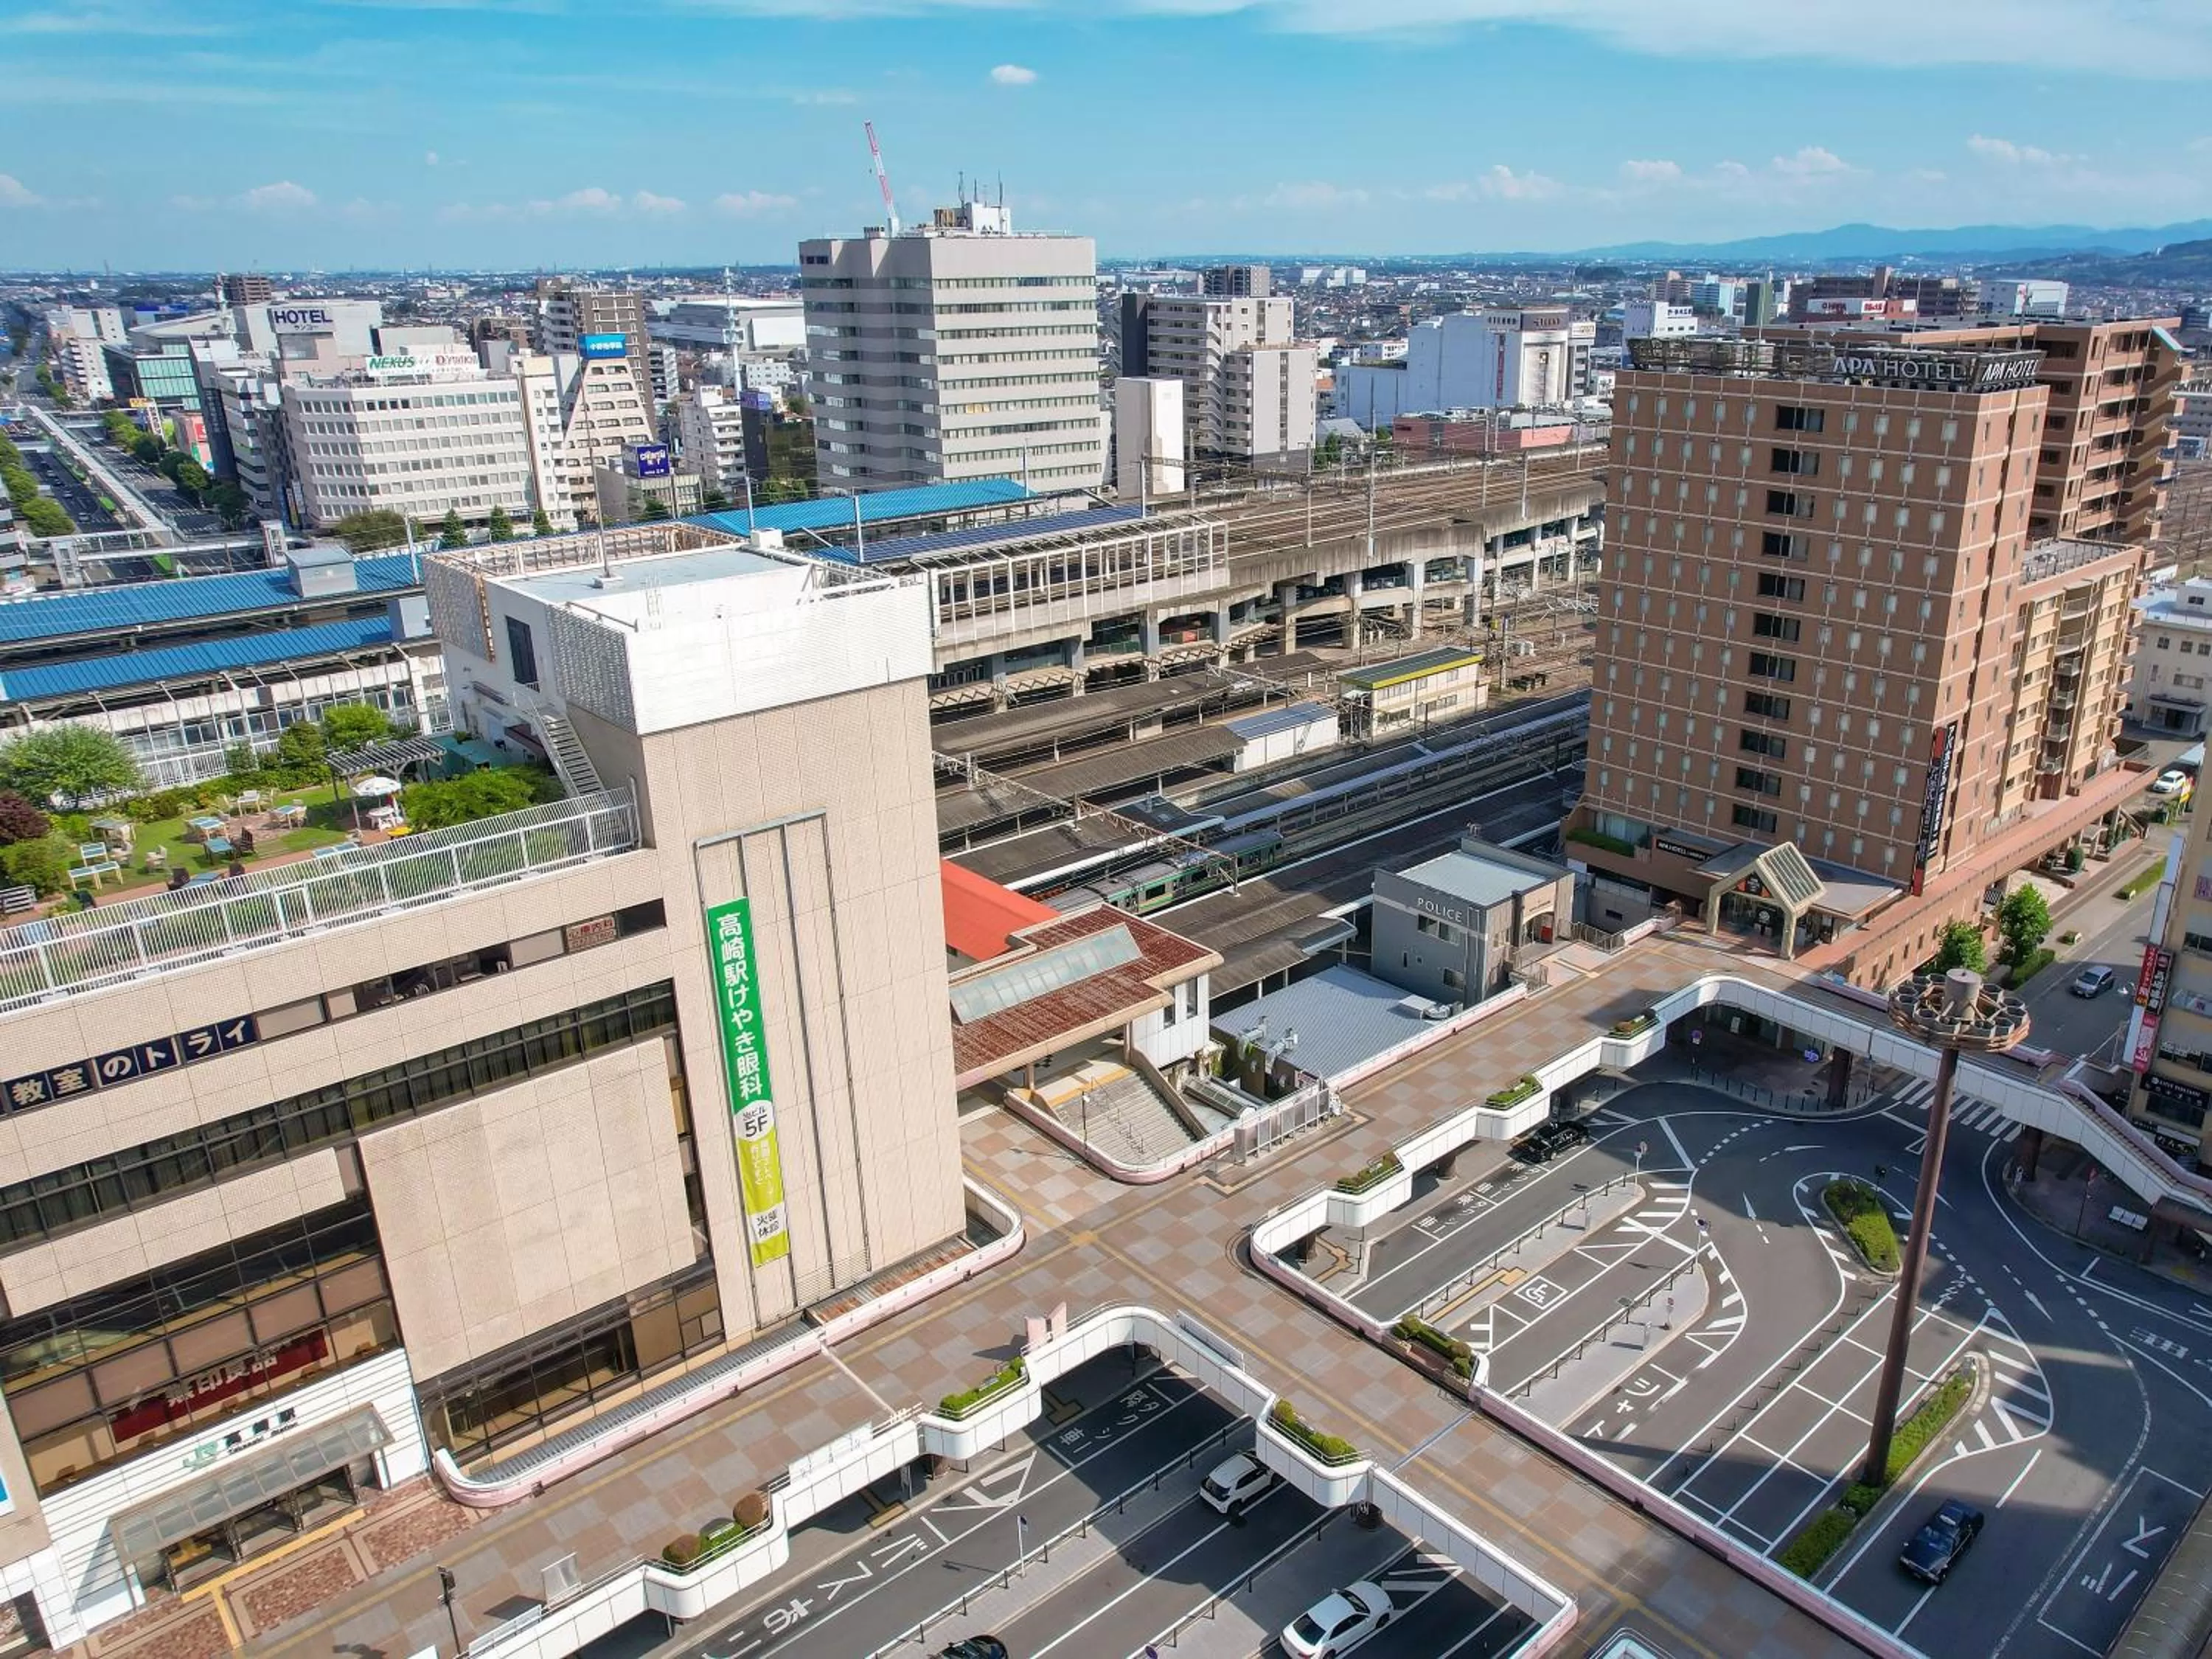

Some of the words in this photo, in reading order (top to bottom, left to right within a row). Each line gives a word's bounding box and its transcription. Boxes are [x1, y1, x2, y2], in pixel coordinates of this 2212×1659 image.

[274, 309, 333, 324] HOTEL
[369, 355, 416, 369] NEXUS
[1833, 357, 1876, 375] APA
[1884, 359, 1963, 380] HOTEL
[1982, 363, 2004, 381] APA
[2006, 359, 2039, 379] HOTEL
[1416, 897, 1463, 922] POLICE
[717, 913, 762, 1101] 高崎駅けやき眼科
[12, 1020, 247, 1106] 教室のトライ
[745, 1114, 768, 1137] 5F
[1073, 1402, 1161, 1453] タクシー
[2081, 1515, 2166, 1601] バス
